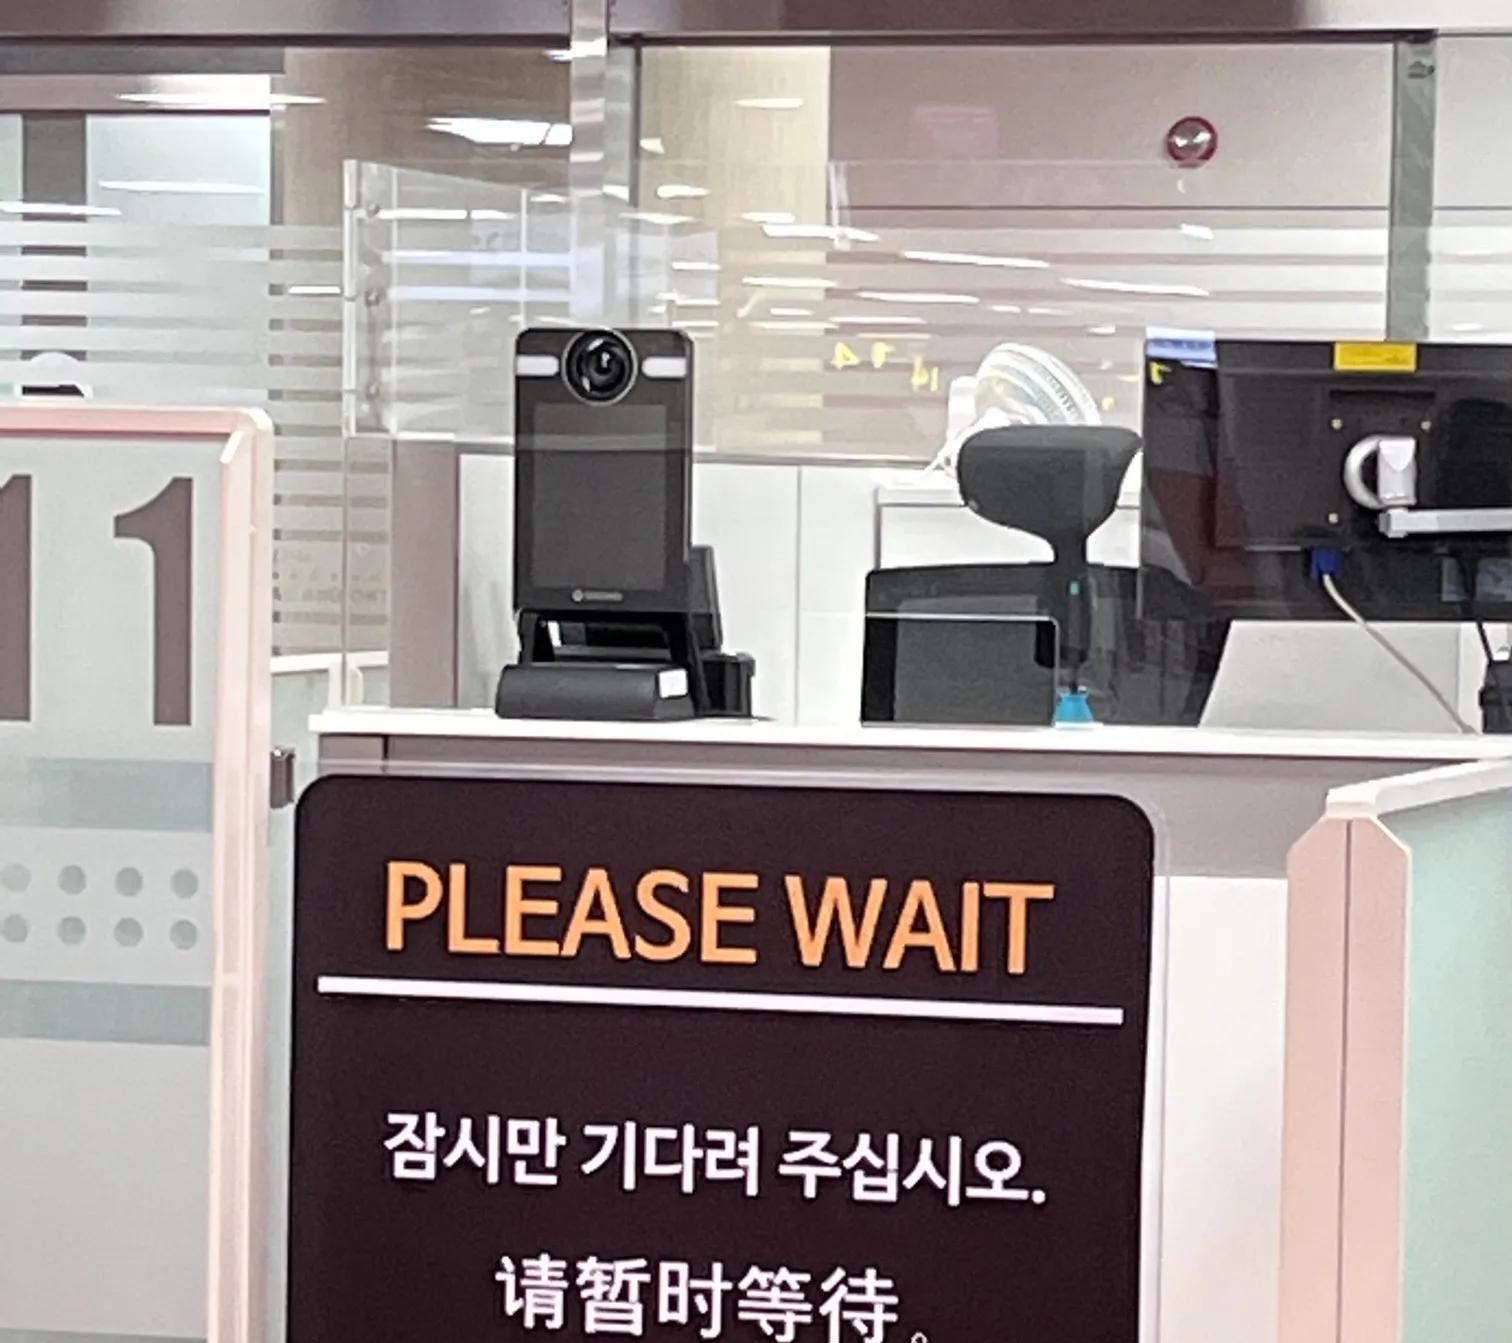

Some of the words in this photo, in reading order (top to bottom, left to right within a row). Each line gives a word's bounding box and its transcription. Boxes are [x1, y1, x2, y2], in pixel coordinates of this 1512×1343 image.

[384, 861, 759, 964] PLEASE
[785, 875, 1054, 974] WAIT
[384, 1112, 566, 1187] 잠시만
[582, 1123, 761, 1197] 기다려
[779, 1130, 1047, 1206] 주십시오.
